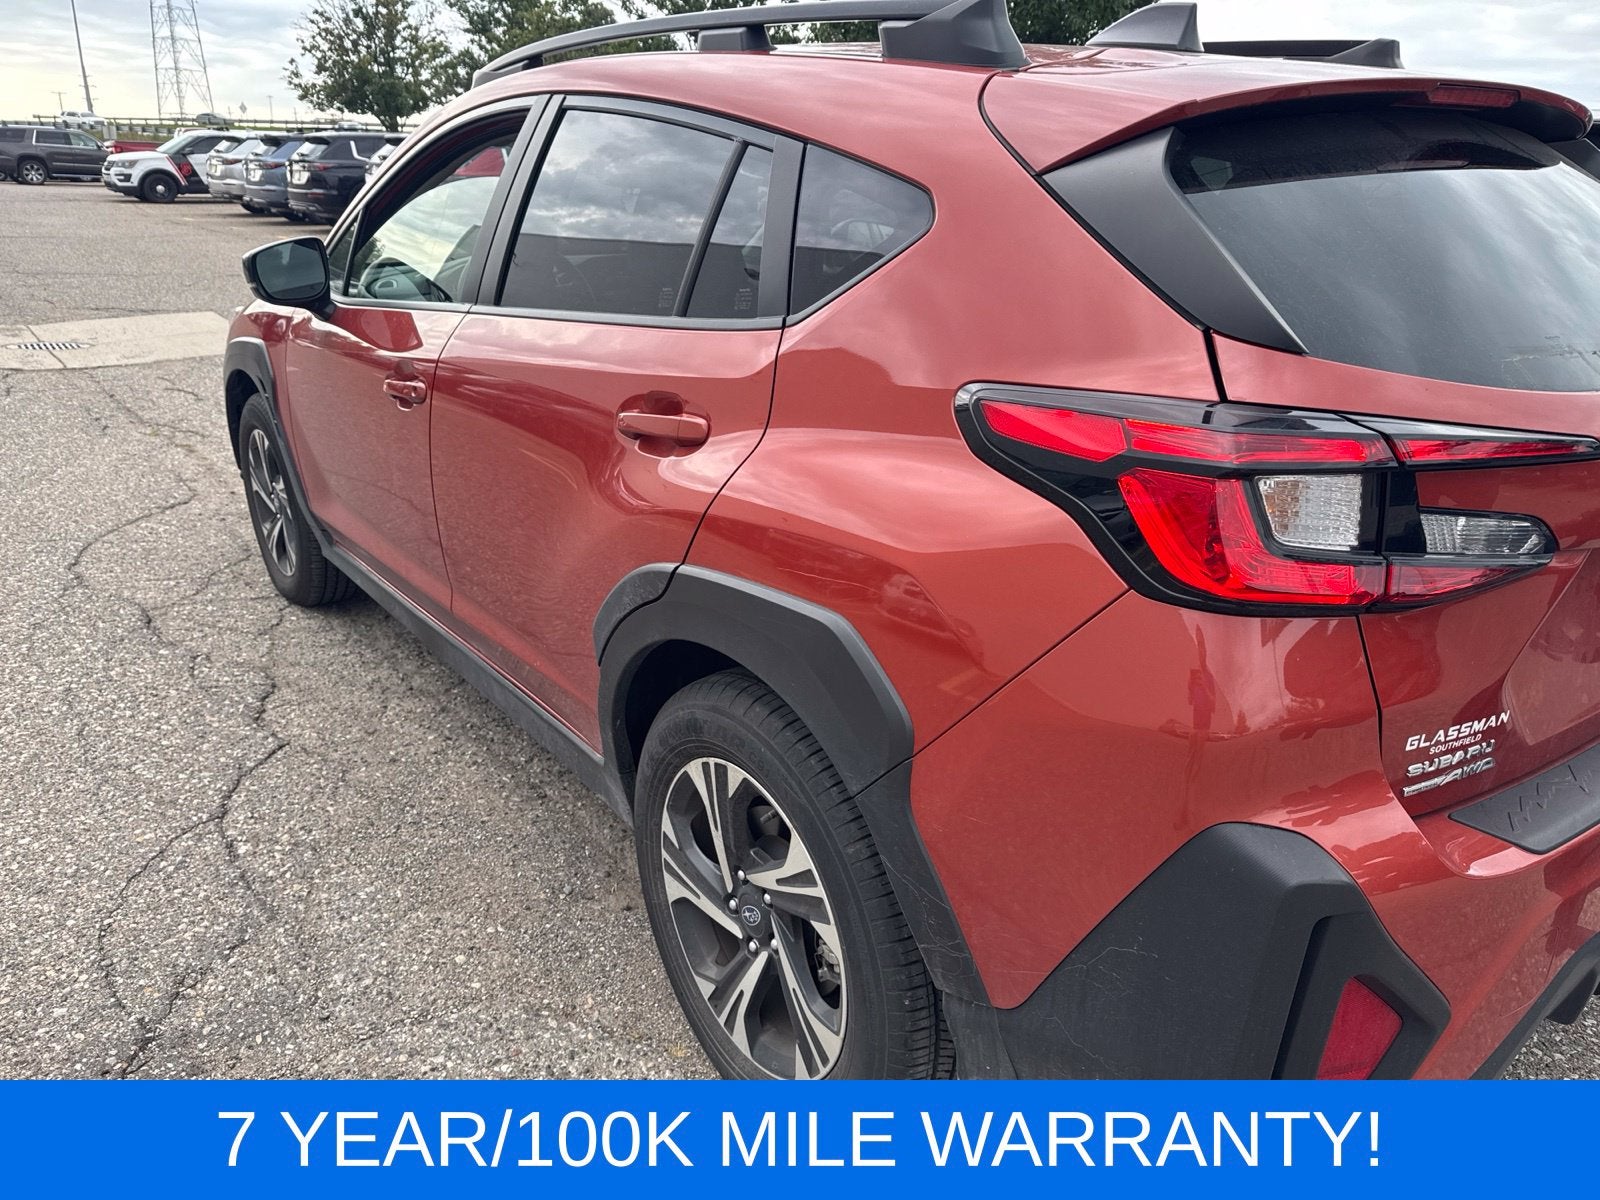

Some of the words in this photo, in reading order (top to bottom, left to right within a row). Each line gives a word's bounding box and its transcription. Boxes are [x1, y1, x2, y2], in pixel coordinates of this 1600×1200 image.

[1406, 710, 1509, 751] GLASSMAN
[1429, 734, 1482, 755] SOUTHFIELD
[1407, 739, 1495, 777] SUBARU
[1440, 757, 1495, 786] AWD
